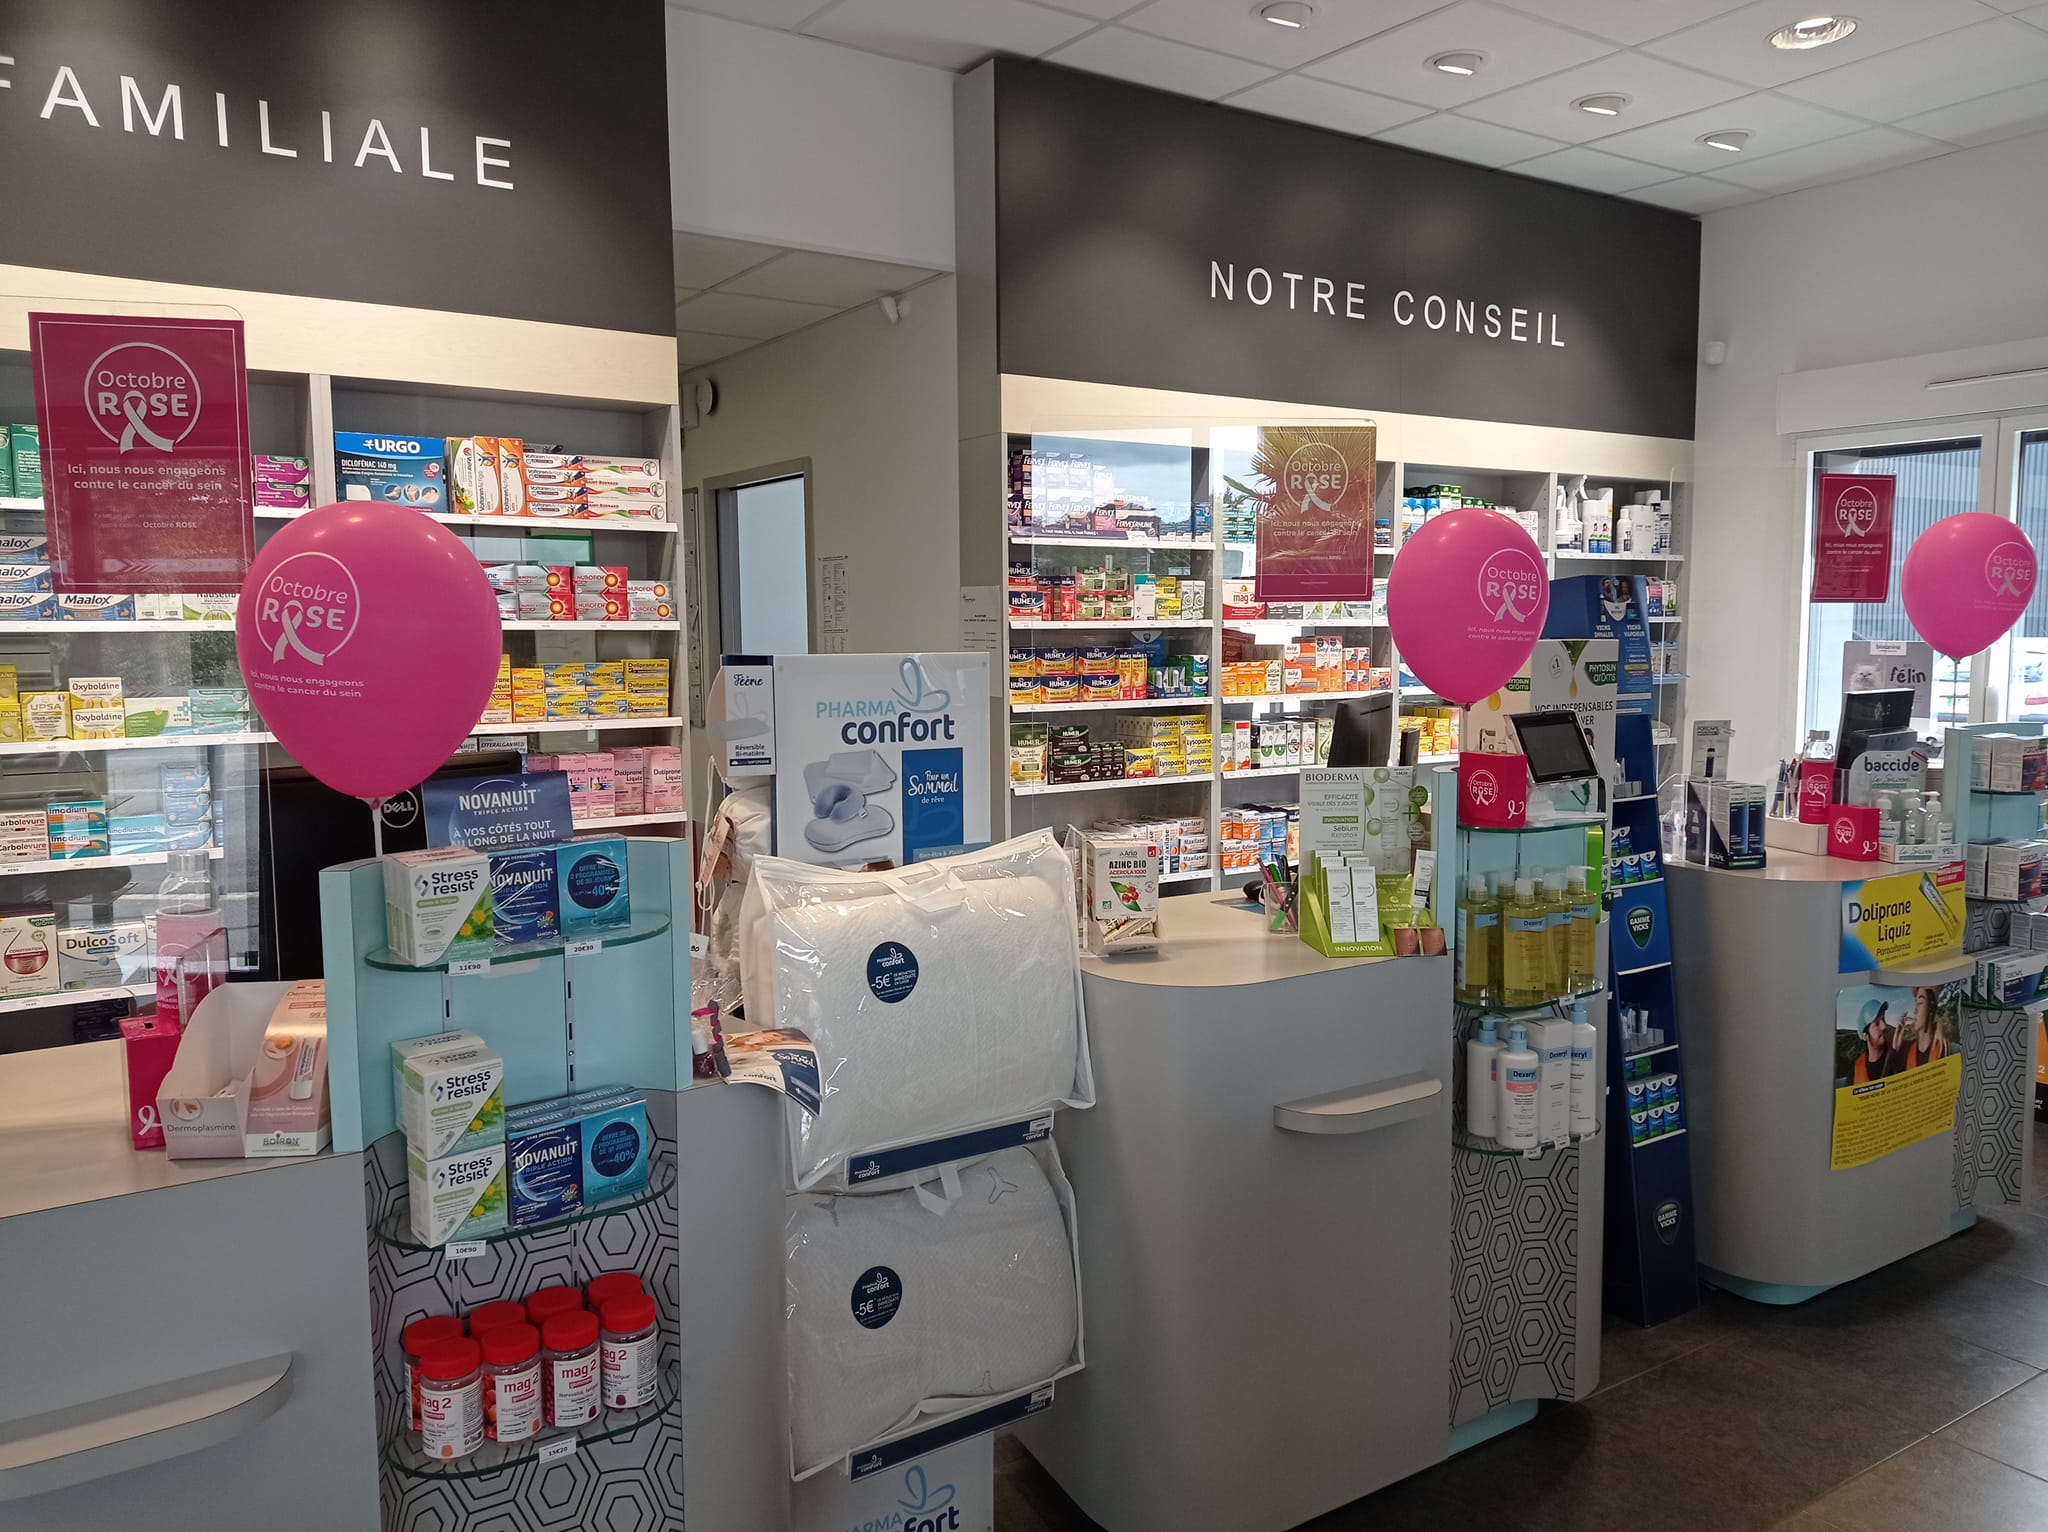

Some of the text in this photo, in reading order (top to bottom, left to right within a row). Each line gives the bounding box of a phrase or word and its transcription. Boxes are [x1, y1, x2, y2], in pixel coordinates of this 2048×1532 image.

[1211, 261, 1565, 348] NOTRE CONSEIL
[97, 370, 187, 390] Octobre
[97, 391, 189, 417] ROSE
[374, 439, 421, 455] URGO
[341, 459, 376, 469] DICLOFÉNAC
[1291, 461, 1341, 472] Octobre
[67, 464, 226, 478] Ici, nous nous engageons
[74, 479, 222, 491] contre le cancer du sein
[1290, 474, 1342, 489] ROSE
[1840, 499, 1873, 509] Octobre
[1839, 509, 1873, 521] ROSE
[143, 521, 175, 529] Octobre
[1993, 555, 2031, 567] Octobre
[1008, 567, 1031, 575] HUMEX
[1486, 566, 1538, 583] Octobre
[1991, 567, 2031, 581] ROSE
[271, 576, 348, 604] Octobre
[1486, 582, 1538, 601] ROSE
[64, 595, 112, 605] Maalox
[1012, 596, 1036, 605] HUMEX
[1233, 594, 1249, 604] mag
[262, 598, 346, 631] ROSE
[1045, 652, 1066, 660] HUMEX
[1087, 651, 1108, 659] HUMEX
[628, 662, 655, 671] Doliprane
[1589, 664, 1617, 672] PHYTOSUN
[545, 670, 571, 679] Doliprane
[586, 670, 611, 679] Doliprane
[260, 672, 364, 689] nous nous engageons
[628, 681, 655, 690] Doliprane
[1010, 681, 1033, 689] HUMEX
[1049, 680, 1071, 688] HUMEX
[1091, 679, 1112, 687] HUMEX
[72, 683, 120, 692] Oxyboldine
[287, 686, 361, 698] cancer du sein
[31, 703, 62, 711] UPSA
[548, 699, 575, 708] Doliprane
[588, 699, 615, 707] Doliprane
[628, 701, 655, 710] Doliprane
[816, 700, 897, 718] PHARMA
[75, 714, 123, 722] Oxyboldine
[1181, 718, 1206, 728] Lysopaine
[841, 711, 955, 745] confort
[1153, 719, 1179, 728] Lysopaine
[1152, 739, 1179, 749] Lysopaine
[1187, 738, 1212, 747] Lysopaine
[1127, 753, 1154, 764] Lysopaine
[1187, 757, 1212, 767] Lysopaine
[1159, 759, 1185, 769] Lysopaine
[1864, 757, 1920, 772] baccide
[588, 767, 613, 775] Doliprane
[614, 769, 643, 779] Doliprane
[653, 768, 681, 777] Doliprane
[925, 770, 939, 781] Pour
[626, 775, 643, 783] Liquiz
[665, 774, 681, 783] Liquiz
[1305, 773, 1360, 781] BIODERMA
[1472, 778, 1493, 787] Octobre
[1472, 786, 1494, 795] ROSE
[459, 789, 537, 811] NOVANUIT
[921, 796, 929, 804] de
[49, 805, 88, 815] Imodium
[383, 801, 414, 813] DELL
[501, 806, 529, 814] ACTION
[453, 820, 551, 838] À VOS CÔTÉS TOUT
[1179, 820, 1201, 828] Maxilase
[51, 832, 89, 843] Imodium
[468, 829, 556, 848] LONG DE LA NUIT
[1184, 837, 1206, 845] Maxilase
[1183, 855, 1205, 863] Maxilase
[1108, 860, 1147, 869] AZINC BIO
[431, 868, 480, 885] Stress
[491, 868, 552, 887] NOVANUIT
[433, 880, 476, 896] resist
[1848, 900, 1912, 924] Doliprane
[1629, 916, 1651, 925] GAMME
[1632, 923, 1650, 932] VICKS
[1878, 921, 1911, 943] Liquiz
[66, 932, 140, 950] DulcoSoft
[1334, 944, 1383, 952] INNOVATION
[1549, 1050, 1568, 1060] Dexeryl
[1513, 1070, 1536, 1079] Dexeryl
[446, 1071, 491, 1089] Stress
[447, 1081, 488, 1100] resist
[512, 1112, 563, 1129] NOVANUIT
[166, 1121, 237, 1134] Dermoplasmine
[263, 1135, 300, 1147] BOIRON
[1025, 1131, 1045, 1141] confort
[515, 1141, 577, 1169] NOVANUIT
[448, 1157, 493, 1175] Stress
[547, 1156, 573, 1168] ACTION
[450, 1168, 489, 1186] resist
[858, 1169, 880, 1179] confort
[1657, 1208, 1678, 1222] GAMME
[1660, 1217, 1676, 1228] VICKS
[562, 1359, 597, 1380] mag 2
[504, 1380, 531, 1394] mag
[442, 1397, 452, 1409] 2
